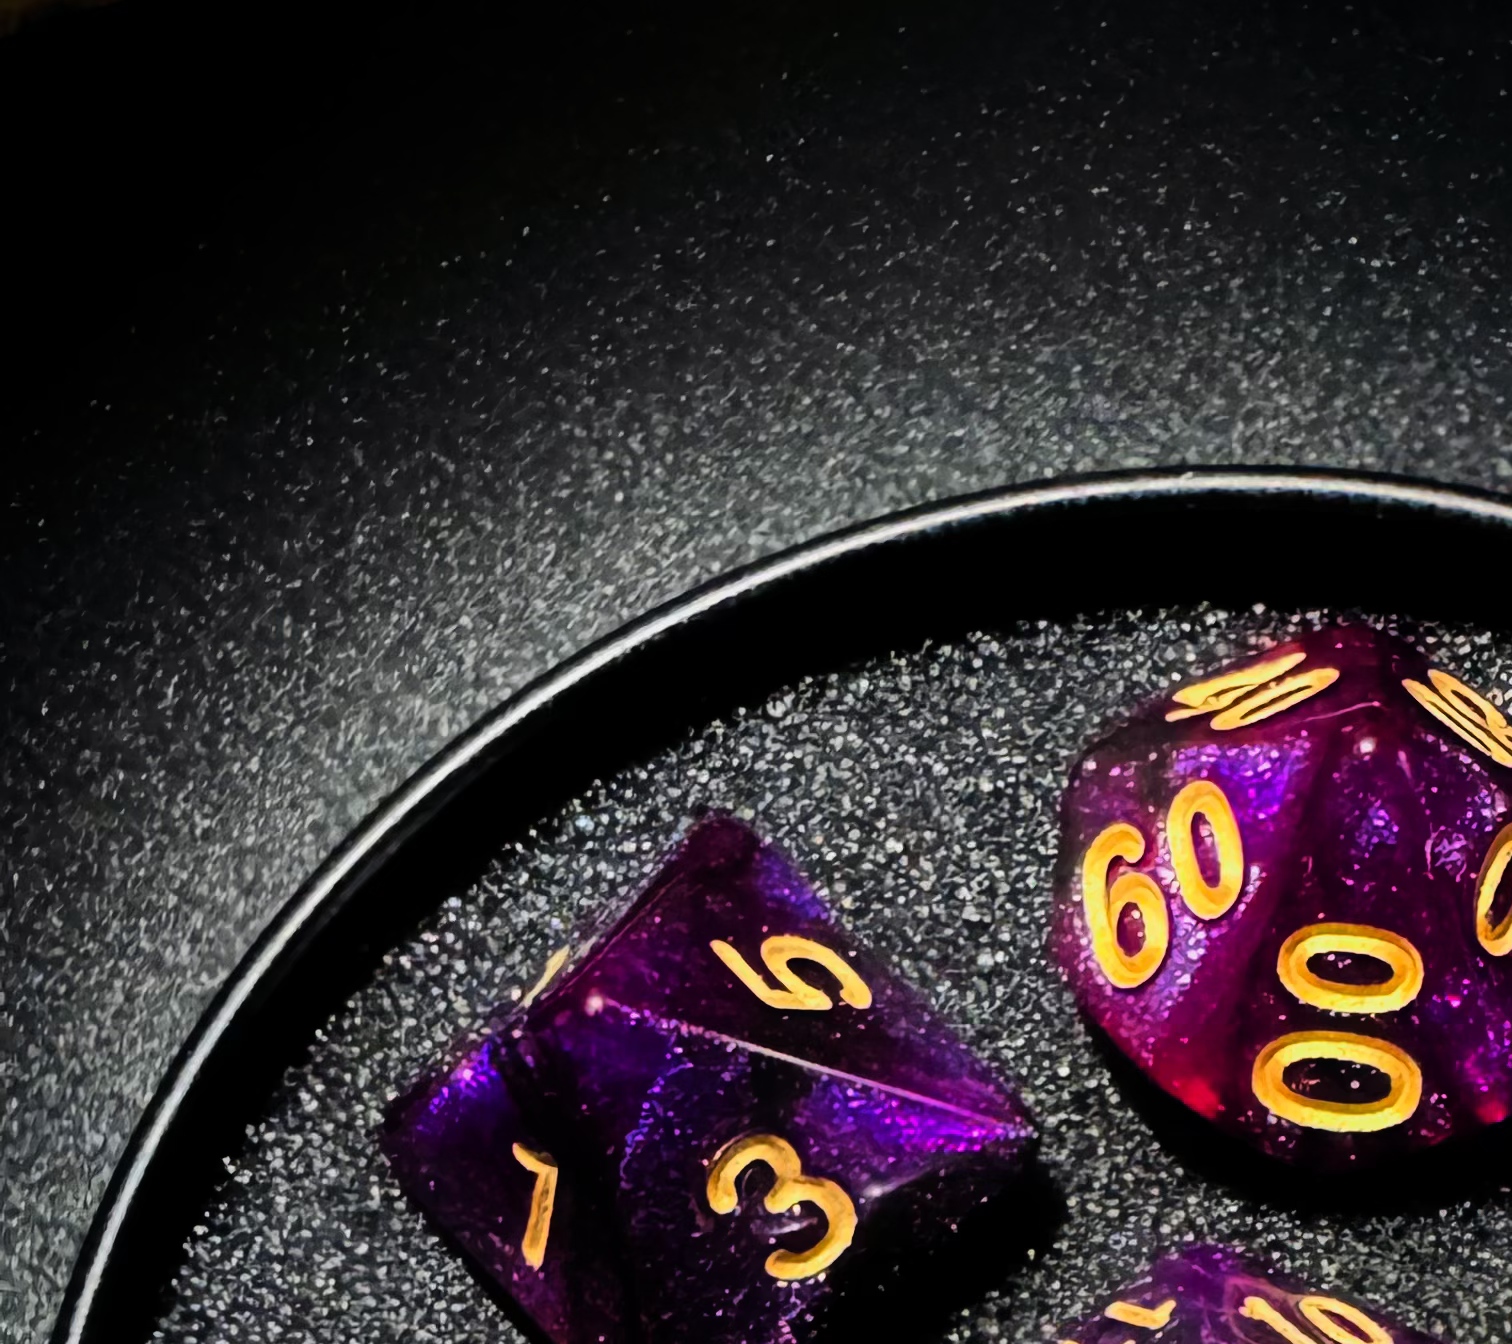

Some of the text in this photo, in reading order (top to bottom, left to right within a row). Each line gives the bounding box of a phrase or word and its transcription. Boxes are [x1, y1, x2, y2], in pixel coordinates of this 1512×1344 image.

[709, 935, 873, 1010] 5
[1083, 780, 1244, 989] 60
[1251, 922, 1424, 1133] 00
[706, 1134, 859, 1280] 3
